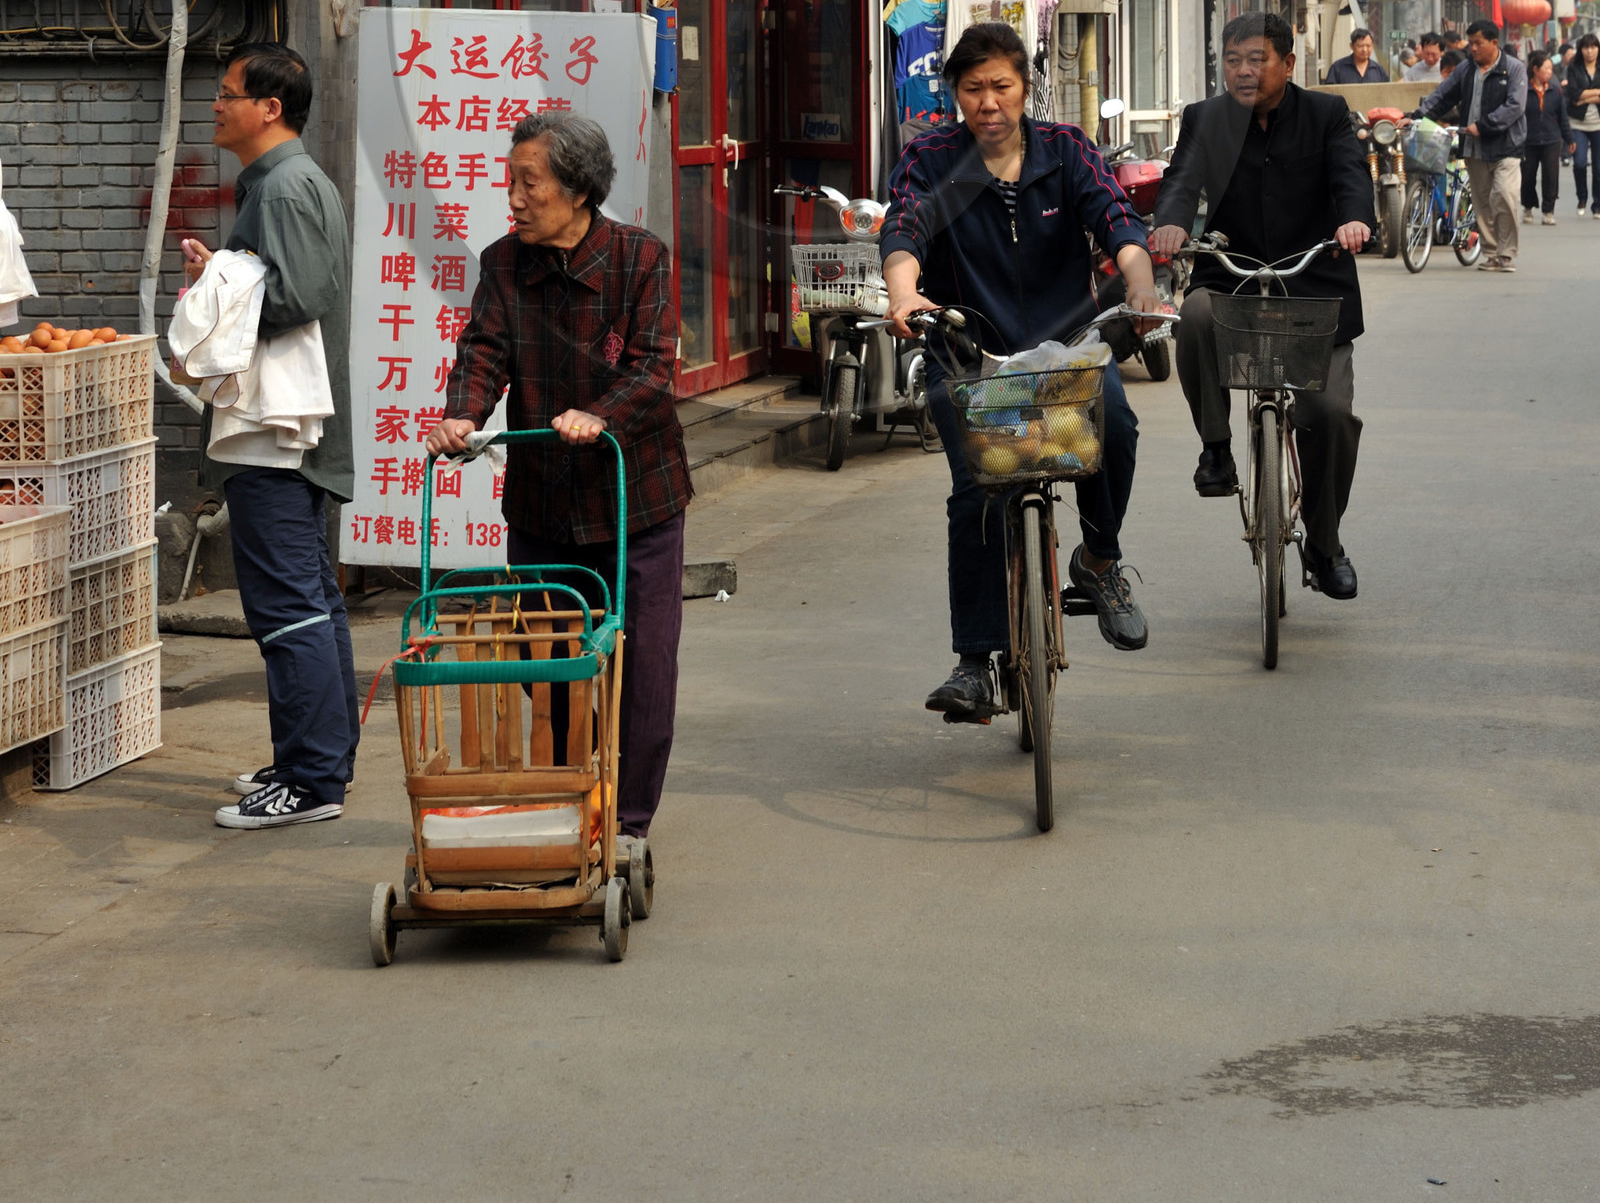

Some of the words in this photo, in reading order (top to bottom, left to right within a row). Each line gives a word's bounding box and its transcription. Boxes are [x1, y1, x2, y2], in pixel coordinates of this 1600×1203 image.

[393, 28, 599, 86] 大运饺子
[382, 202, 470, 241] 川菜
[381, 252, 466, 292] 啤酒
[378, 304, 471, 343] 干锅
[370, 457, 463, 498] 手擀面
[465, 523, 509, 548] 138
